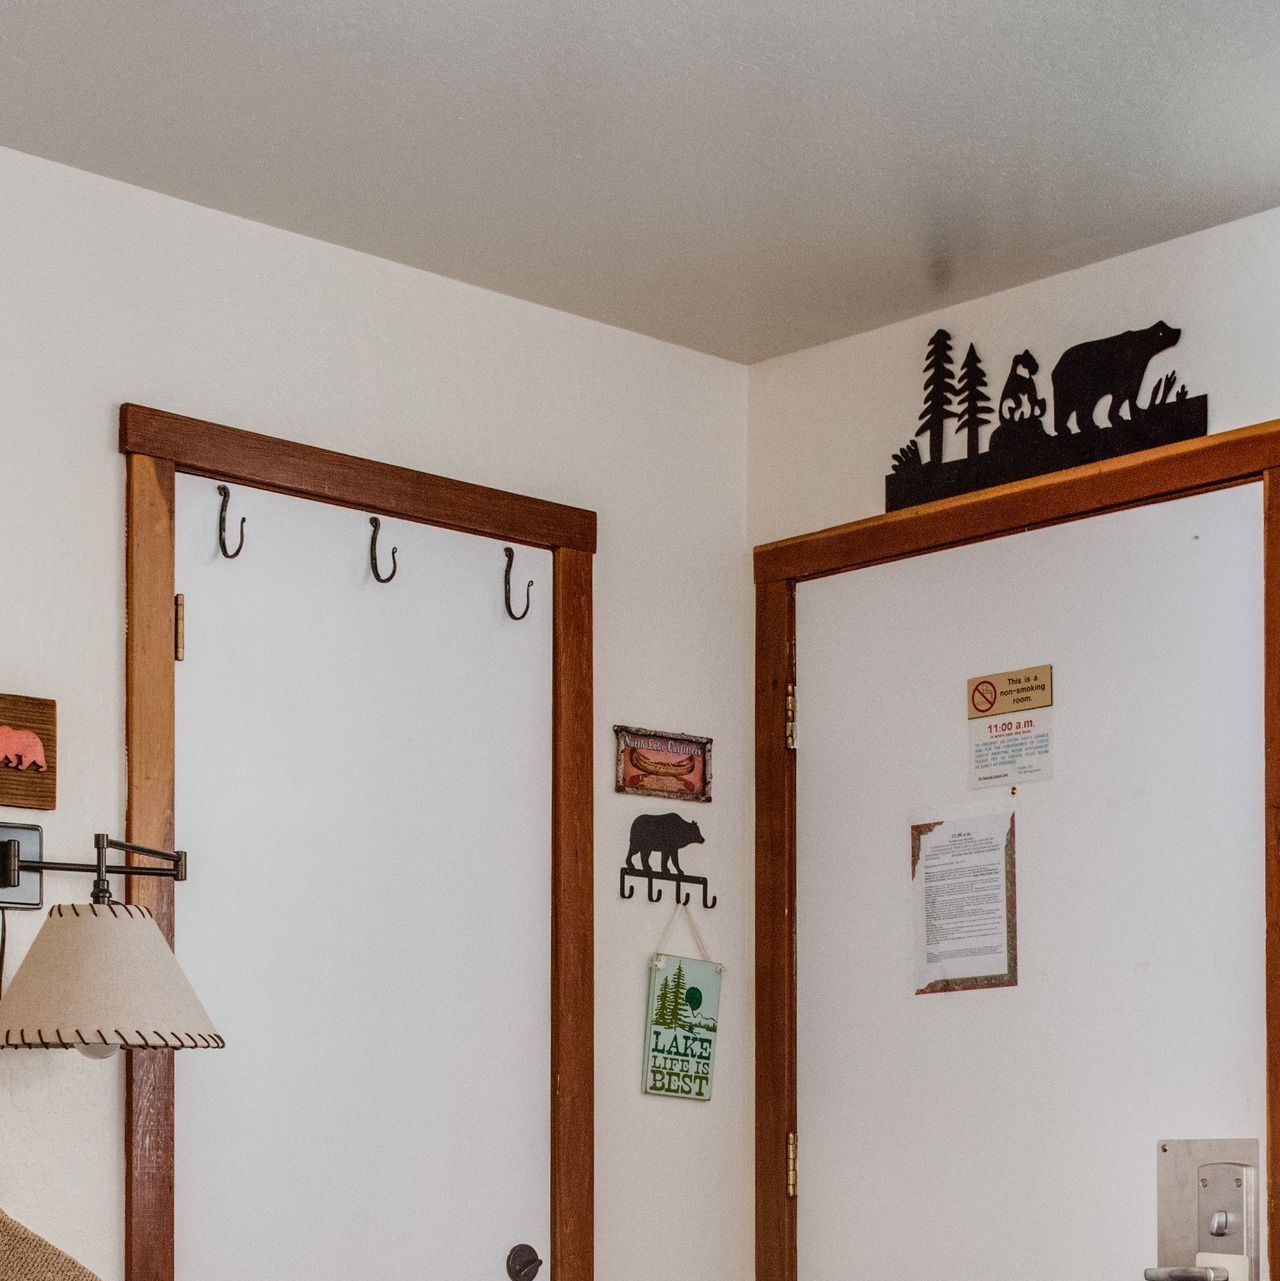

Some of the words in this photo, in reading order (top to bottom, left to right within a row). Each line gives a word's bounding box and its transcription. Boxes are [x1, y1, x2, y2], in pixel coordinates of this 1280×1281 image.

[1007, 677, 1022, 686] This
[1024, 675, 1031, 683] is
[1000, 683, 1046, 697] non-smoking
[1012, 696, 1033, 704] room.
[987, 721, 1013, 734] 11:00
[1016, 719, 1036, 730] a.m.
[651, 1030, 712, 1060] LAKE
[651, 1055, 690, 1073] LIFE
[694, 1060, 710, 1075] IS
[649, 1069, 709, 1096] BEST
